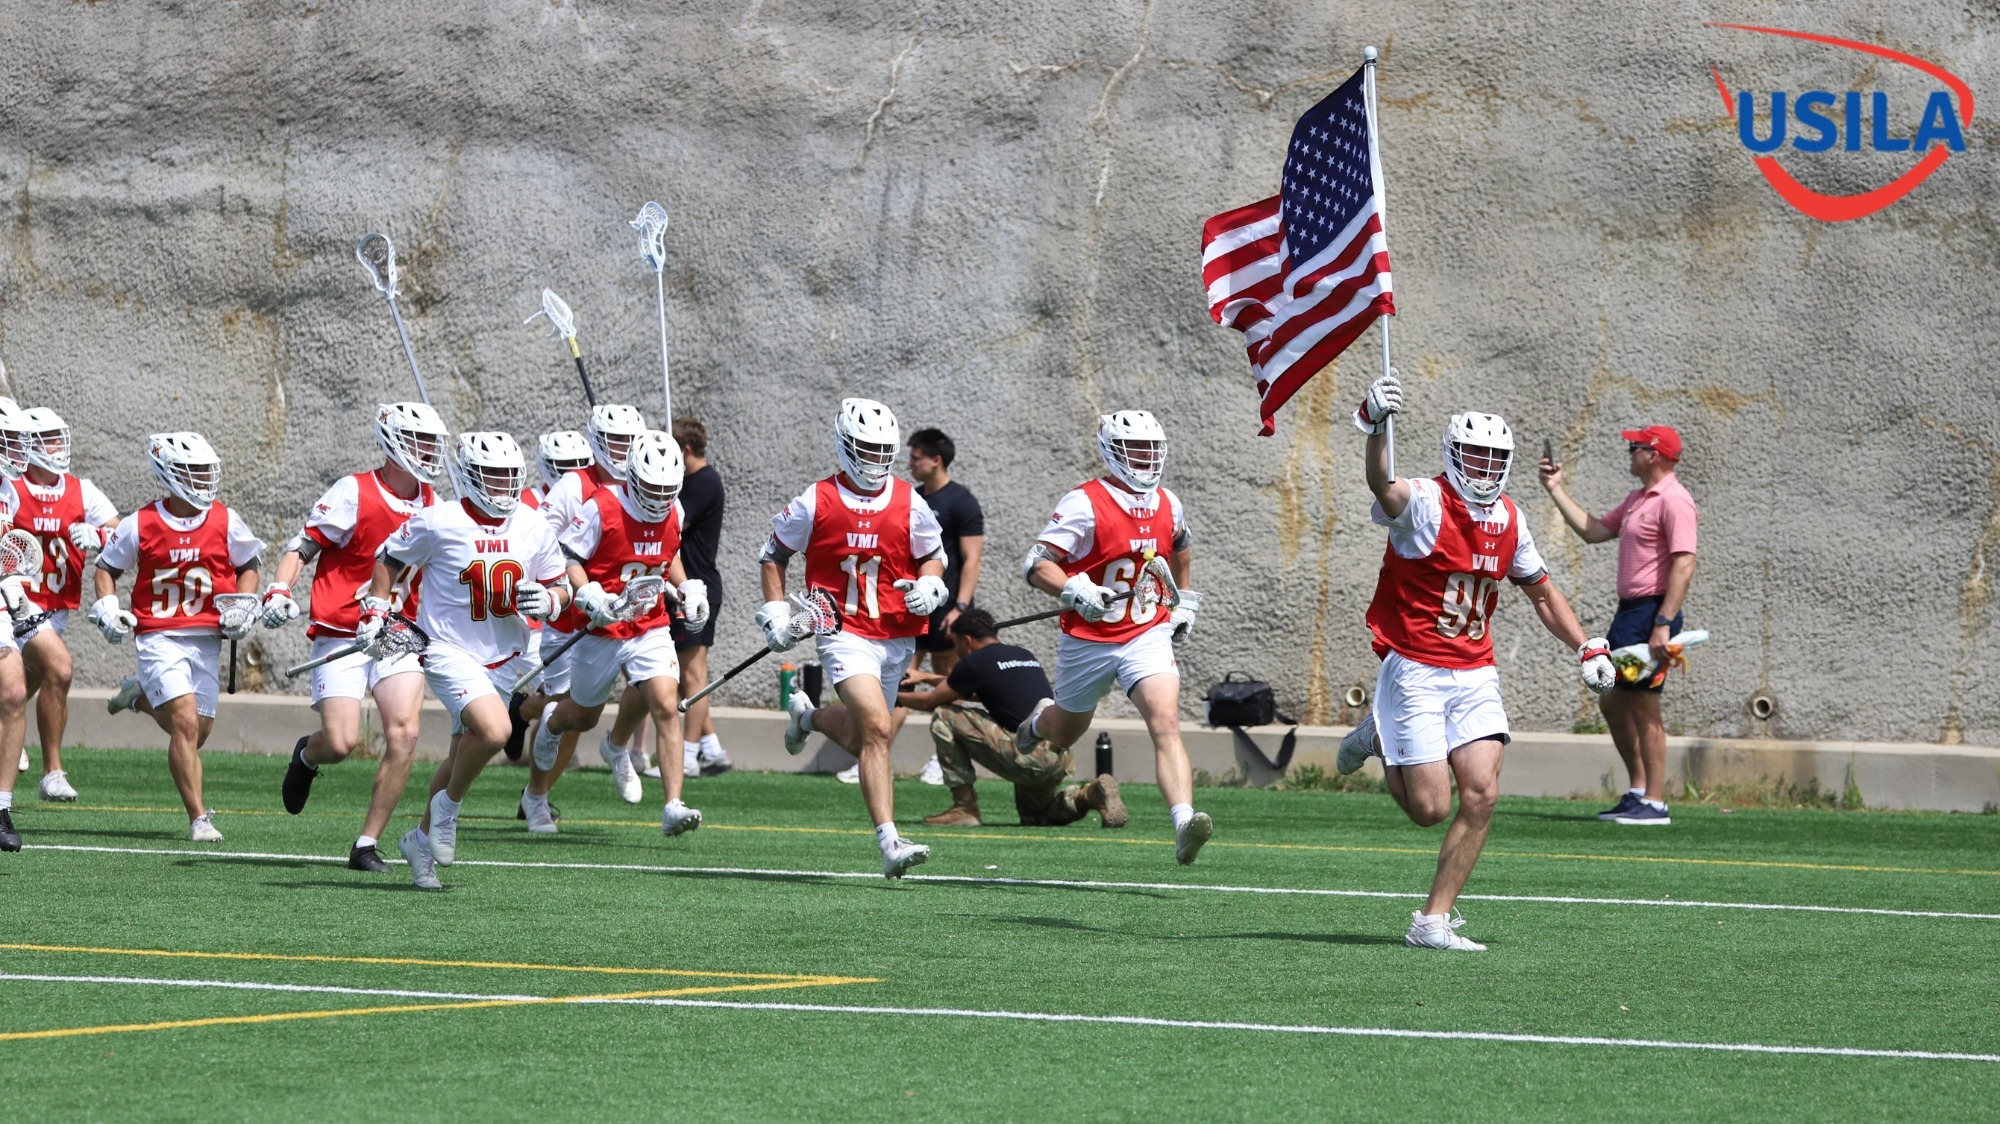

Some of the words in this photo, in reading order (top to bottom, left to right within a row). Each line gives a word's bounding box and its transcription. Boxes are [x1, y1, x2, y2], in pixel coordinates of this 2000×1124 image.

[33, 517, 61, 531] VMI
[474, 539, 509, 553] VMI
[633, 541, 662, 556] VMI
[846, 532, 879, 549] VMI
[1129, 538, 1158, 553] VMI
[169, 548, 201, 563] VMI
[1472, 553, 1499, 572] VMI
[151, 566, 213, 619] 50
[460, 559, 524, 621] 10
[839, 554, 882, 619] 11
[1436, 571, 1499, 640] 99
